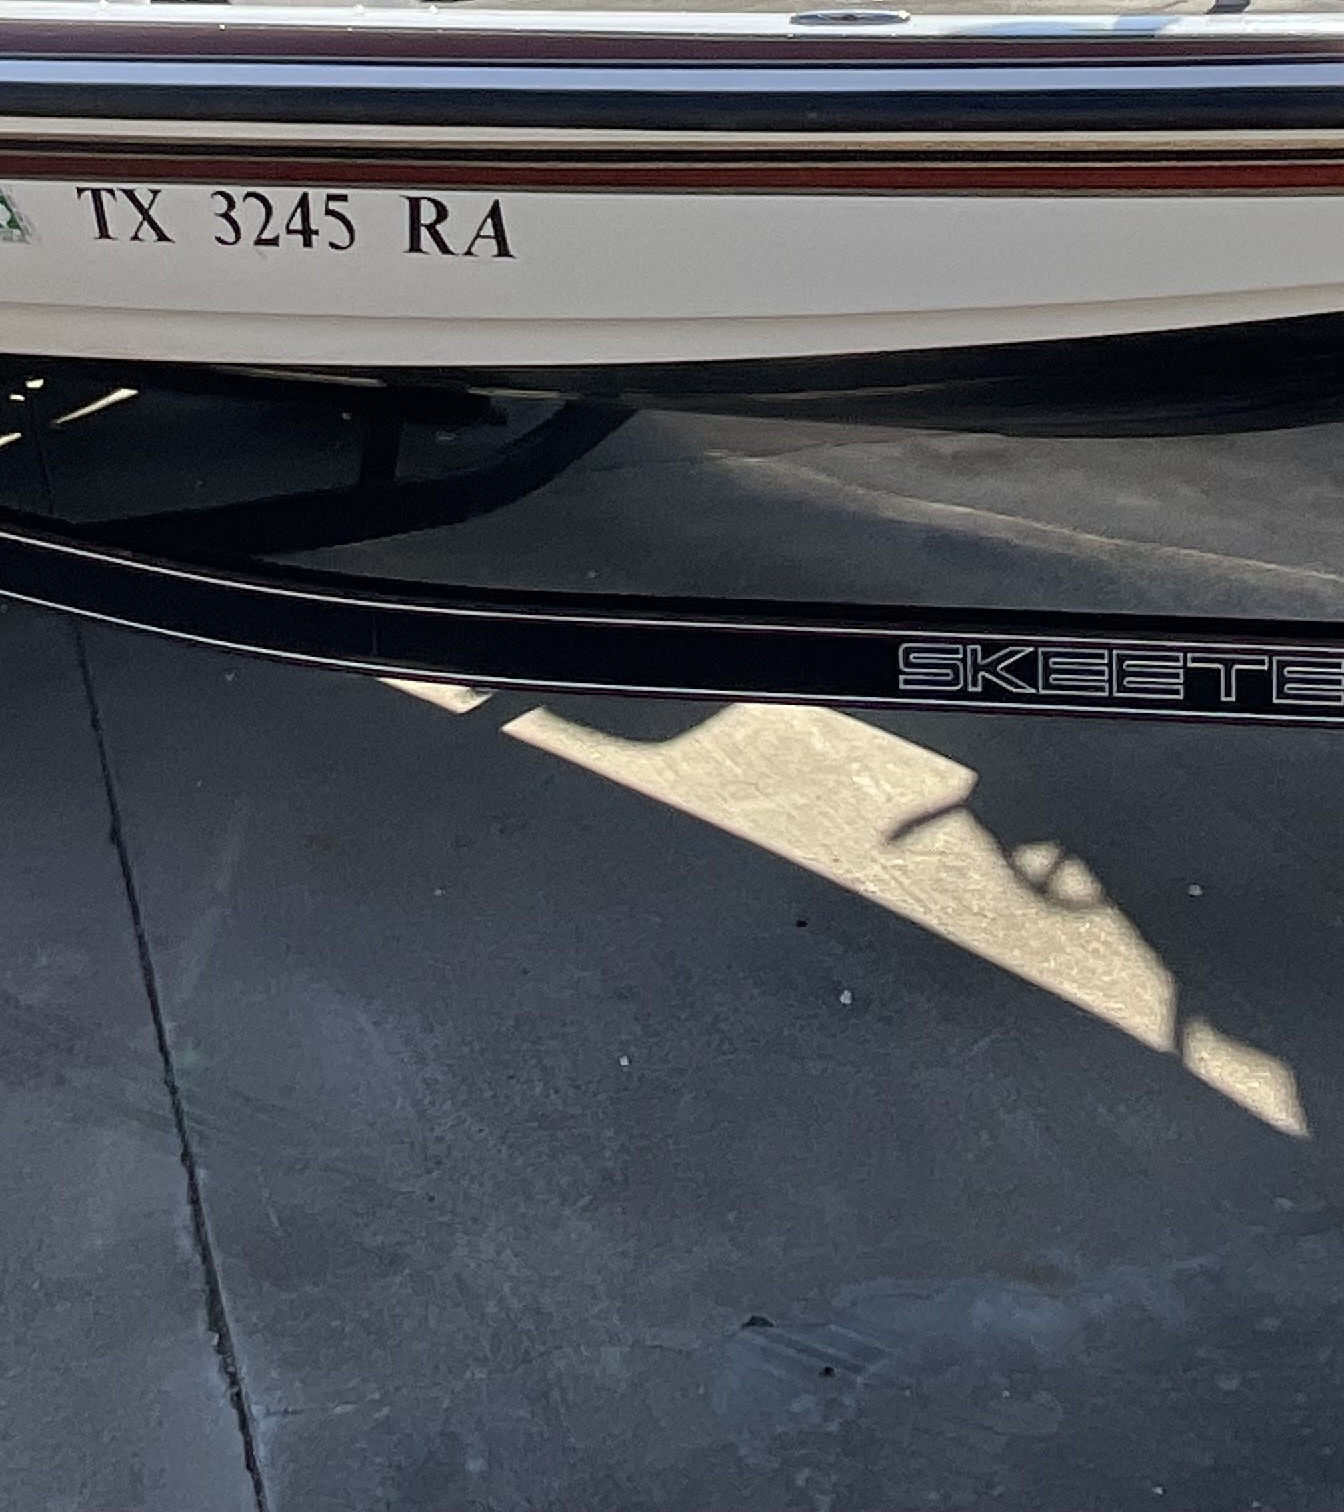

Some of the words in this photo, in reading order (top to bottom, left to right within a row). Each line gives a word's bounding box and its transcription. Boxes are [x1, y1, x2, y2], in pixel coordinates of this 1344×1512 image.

[76, 187, 175, 243] TX
[211, 190, 356, 250] 3245
[401, 195, 516, 259] RA
